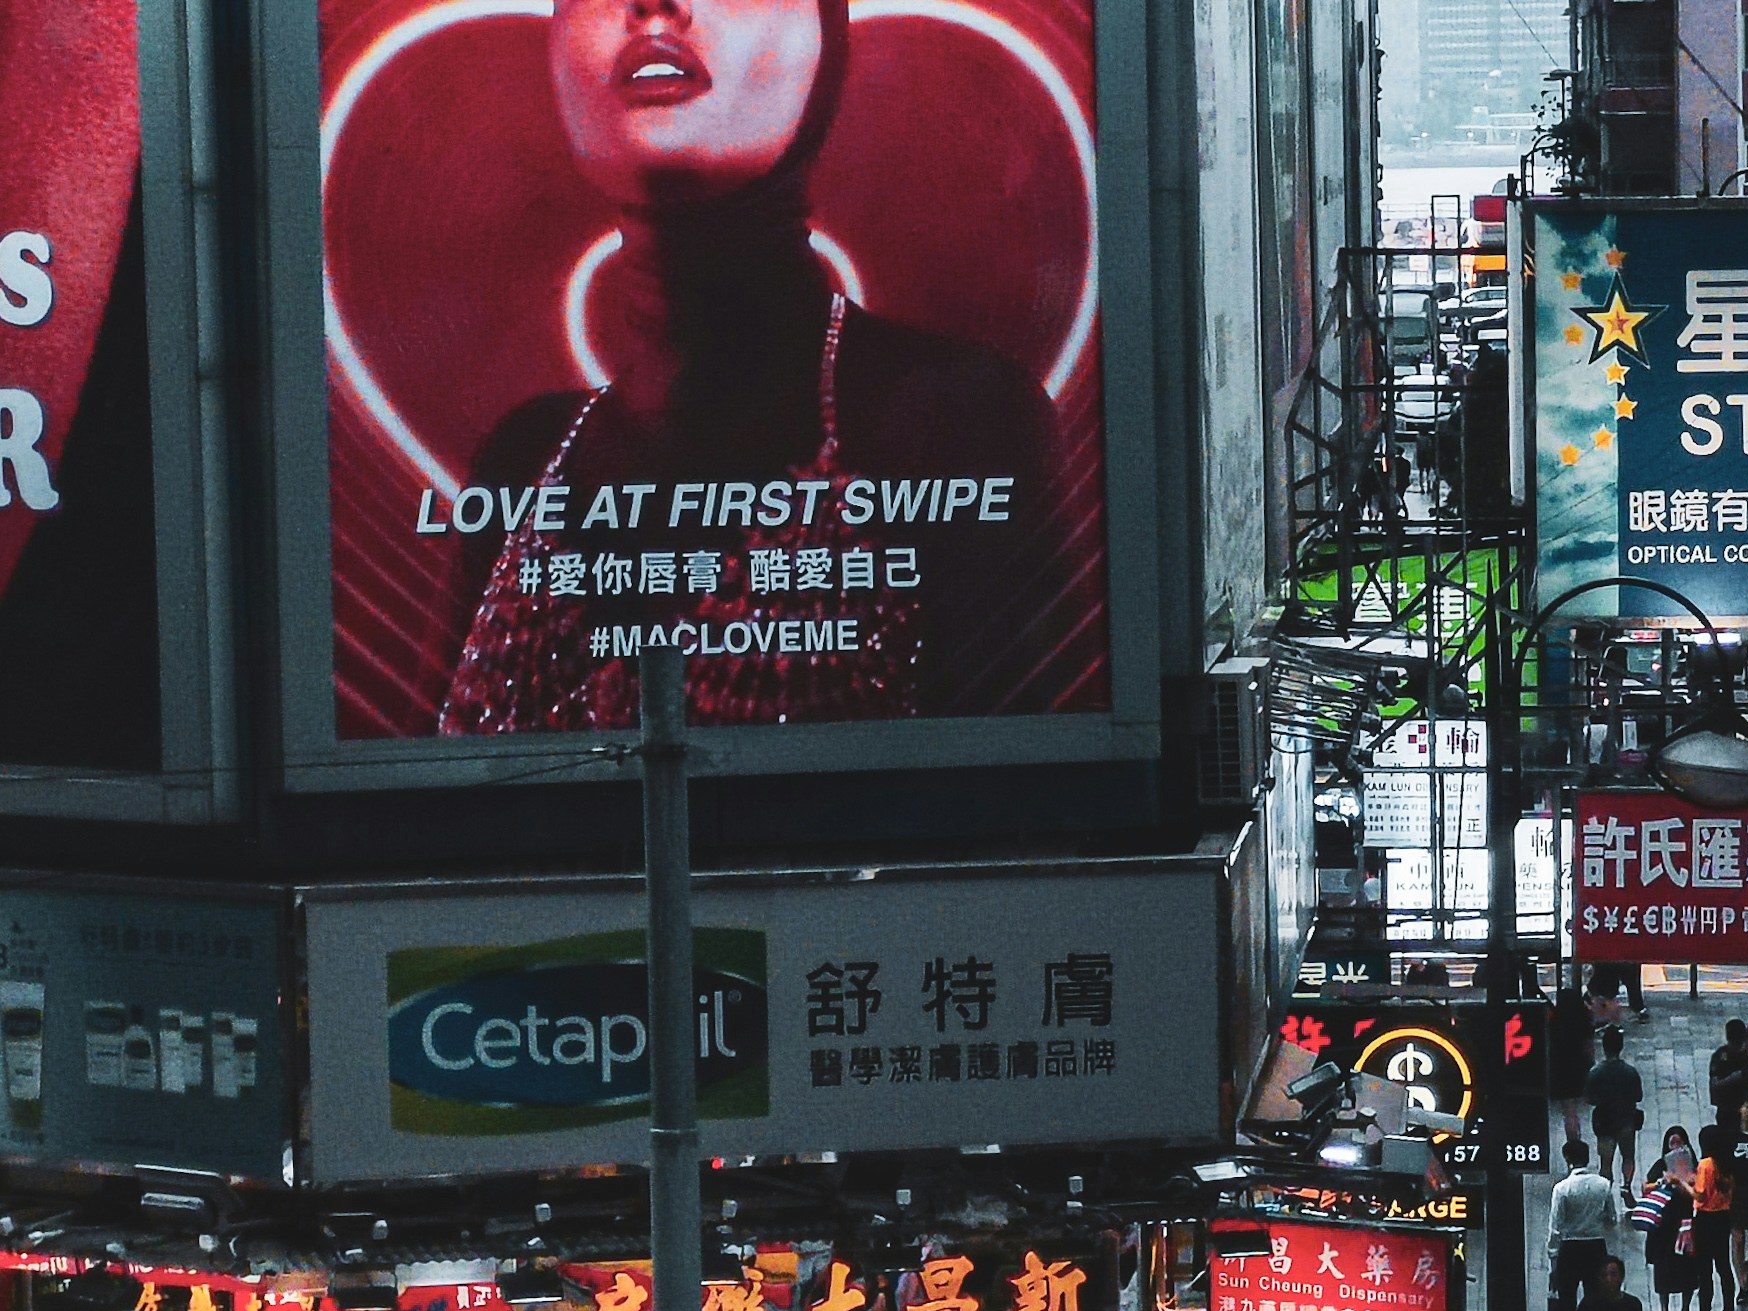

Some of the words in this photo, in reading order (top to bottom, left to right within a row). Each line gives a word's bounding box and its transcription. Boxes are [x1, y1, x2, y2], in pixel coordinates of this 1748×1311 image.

[416, 486, 571, 534] LOVE
[581, 484, 660, 530] AT
[668, 481, 830, 529] FIRST
[841, 477, 1015, 525] SWIPE
[748, 546, 922, 592] 酷愛自己
[1627, 545, 1718, 565] OPTICAL
[806, 954, 1116, 1037] 舒特膚
[420, 992, 737, 1083] Cetapil
[1218, 1273, 1249, 1288] Sun
[1259, 1276, 1324, 1298] Cheung
[1339, 1284, 1435, 1309] Dispensary
